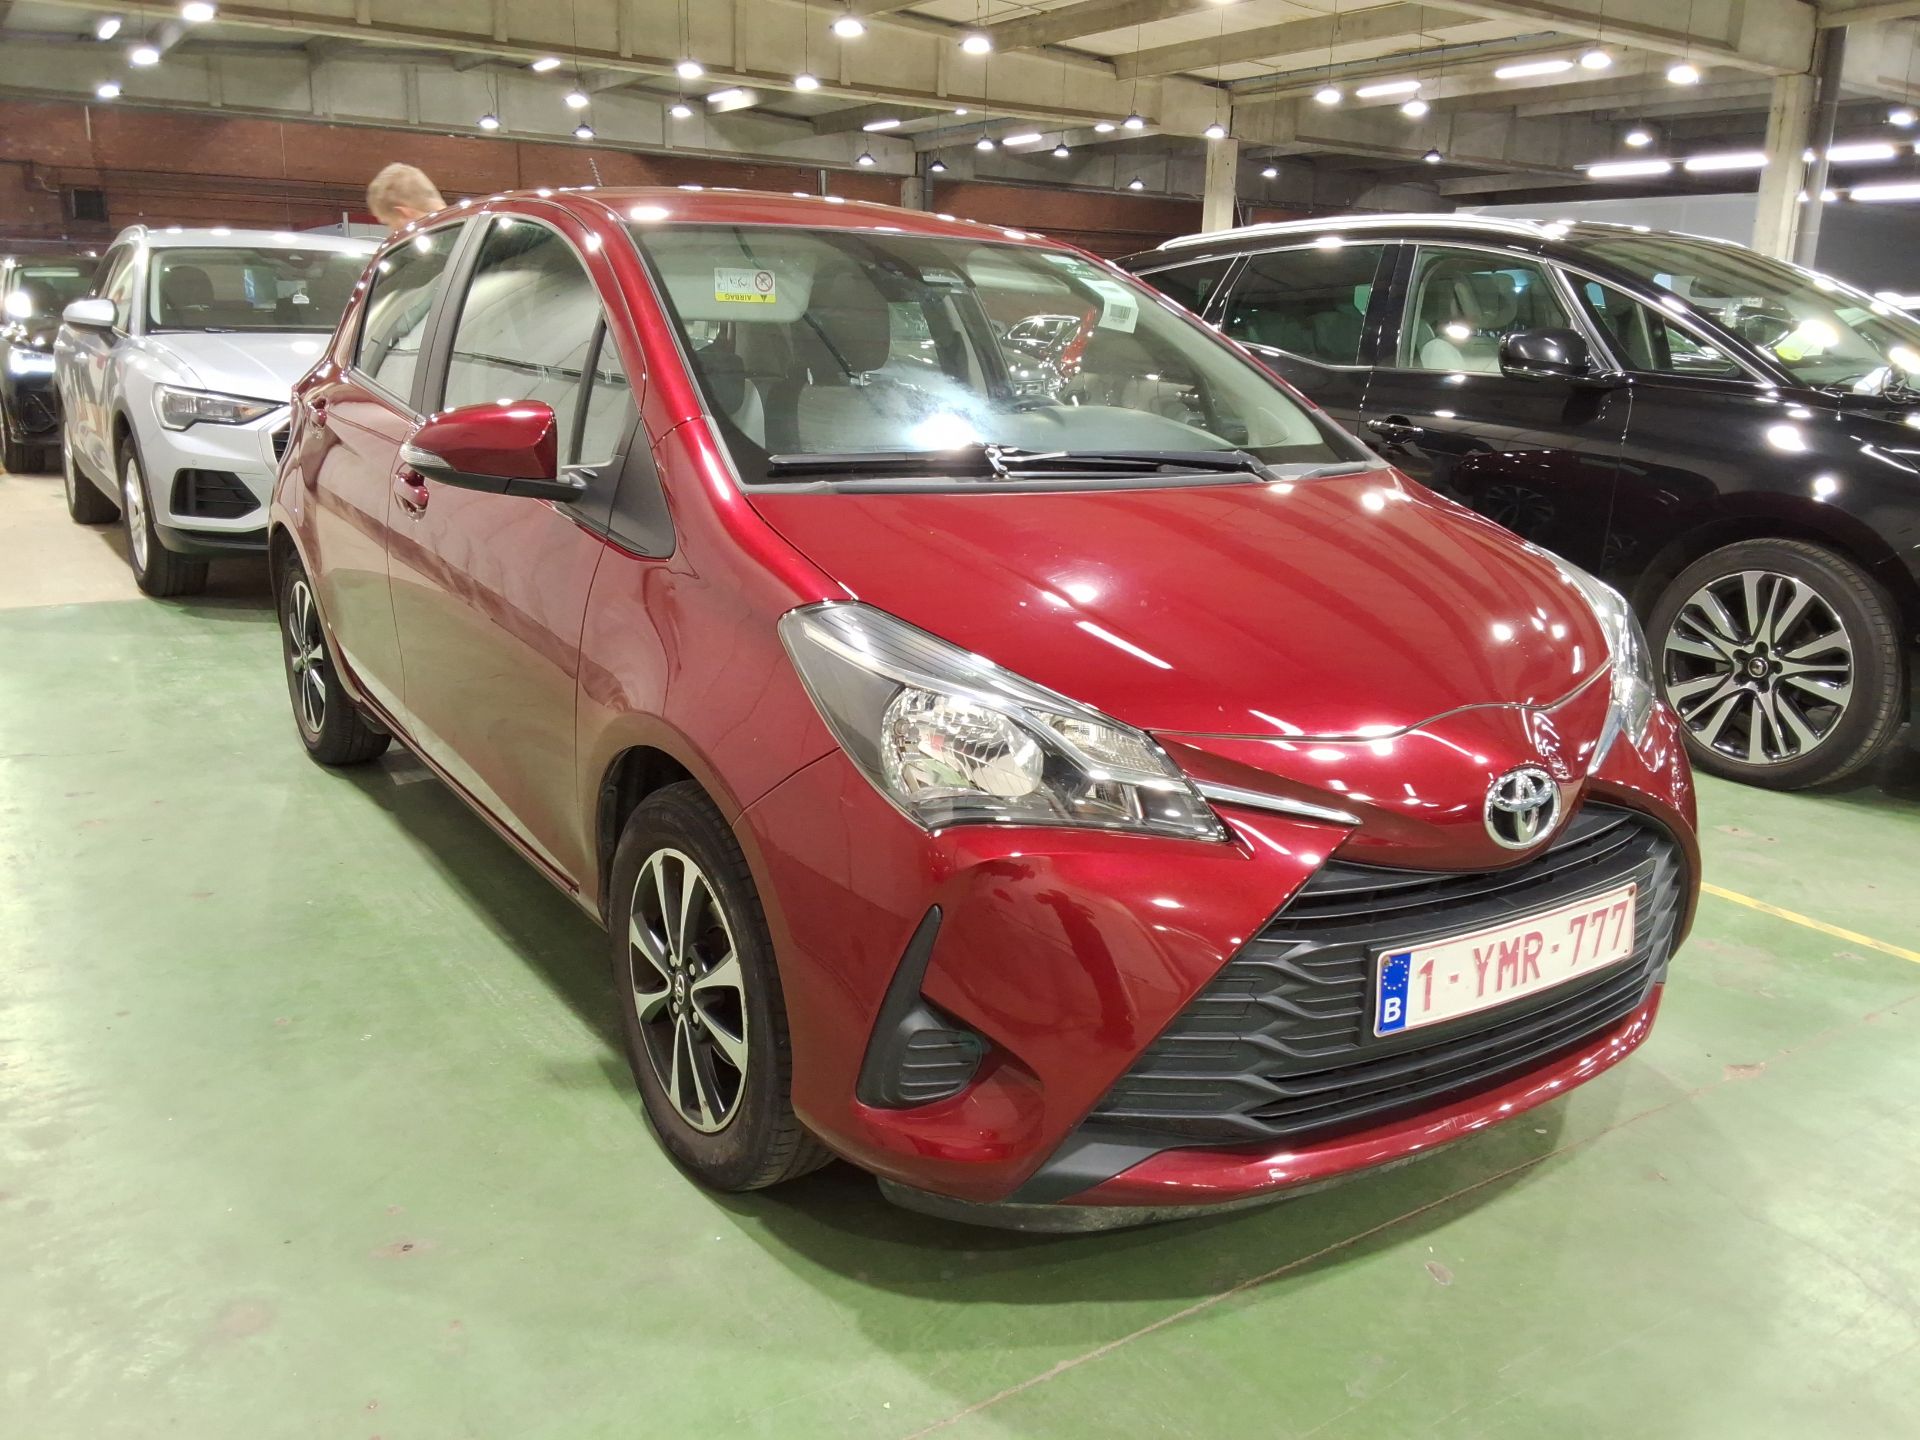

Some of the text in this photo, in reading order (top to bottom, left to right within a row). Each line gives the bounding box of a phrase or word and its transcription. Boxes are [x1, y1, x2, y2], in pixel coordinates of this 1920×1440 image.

[725, 293, 752, 301] AIRBAG
[1419, 901, 1628, 1012] 1-YMR-777
[1384, 997, 1401, 1023] B
